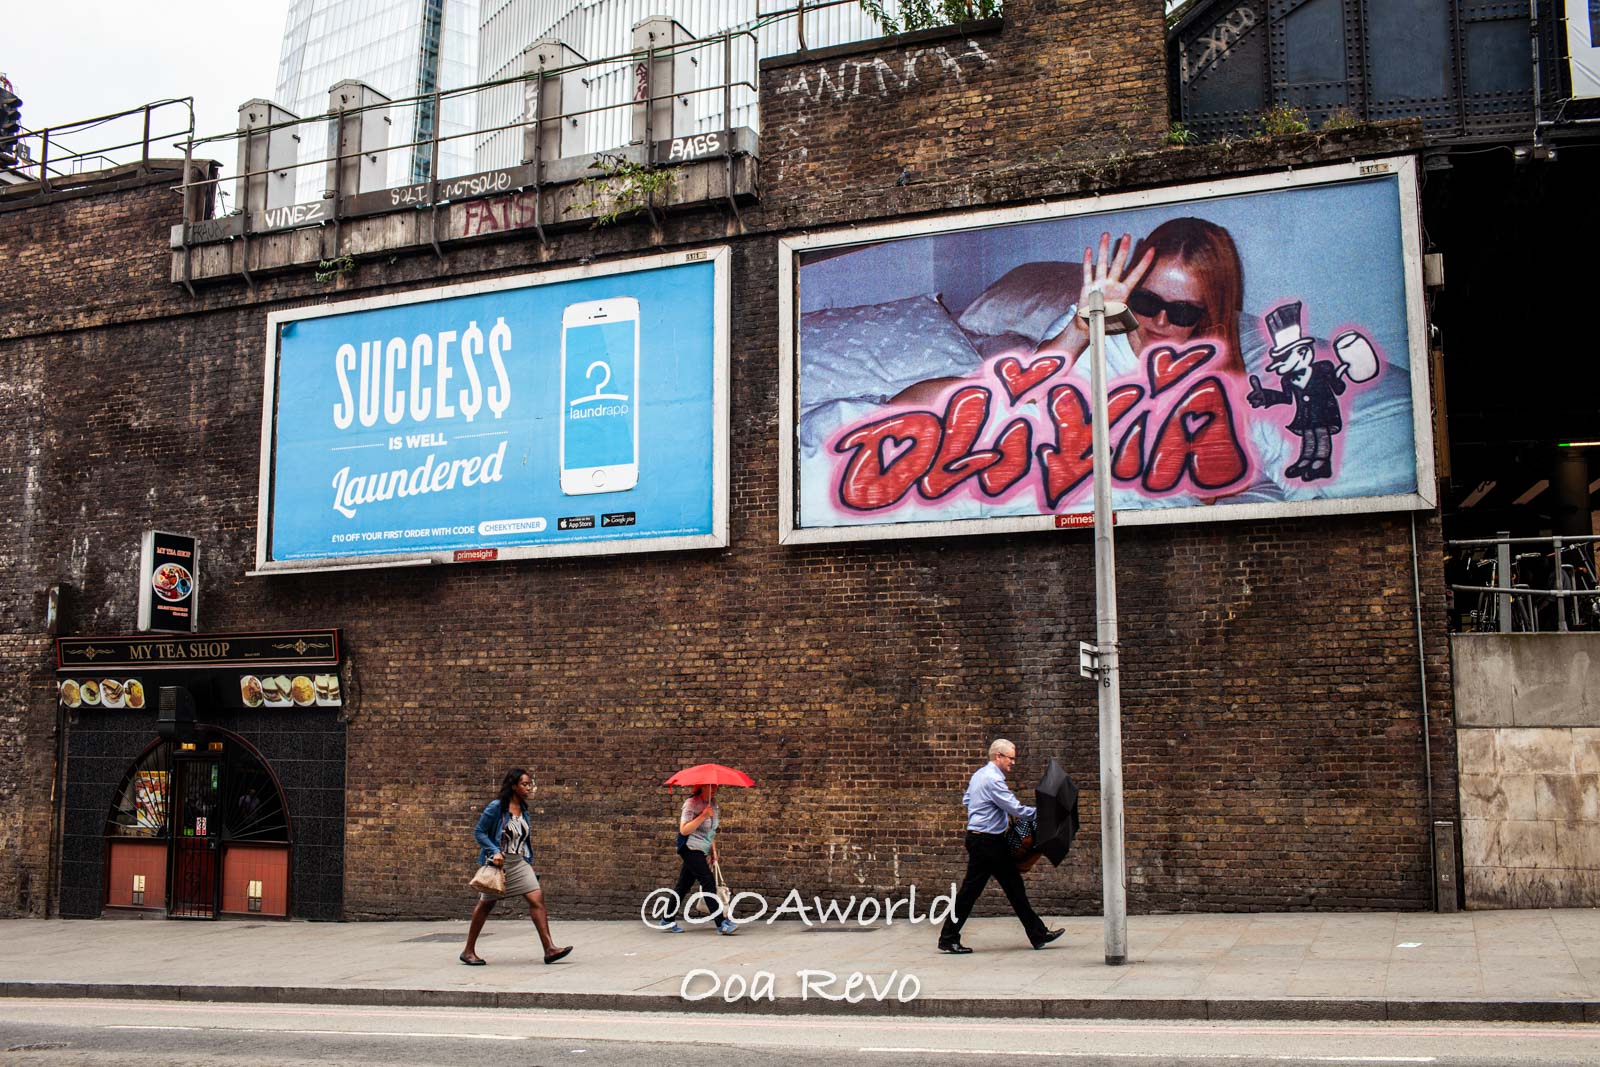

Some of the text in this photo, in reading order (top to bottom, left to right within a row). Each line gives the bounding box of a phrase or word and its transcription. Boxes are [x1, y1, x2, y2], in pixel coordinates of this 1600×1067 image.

[333, 317, 511, 430] SUCCE$$
[570, 404, 629, 419] laundrapp
[388, 433, 448, 450] IS WELL
[332, 440, 508, 519] Laundered
[611, 517, 625, 525] Google
[1061, 515, 1095, 526] primesi
[331, 520, 541, 543] £10 OFF YOUR FIRST ORDER WITH CODE CHEEKYTENNER
[457, 549, 493, 560] primesight
[128, 642, 230, 660] MY TEA SHOP
